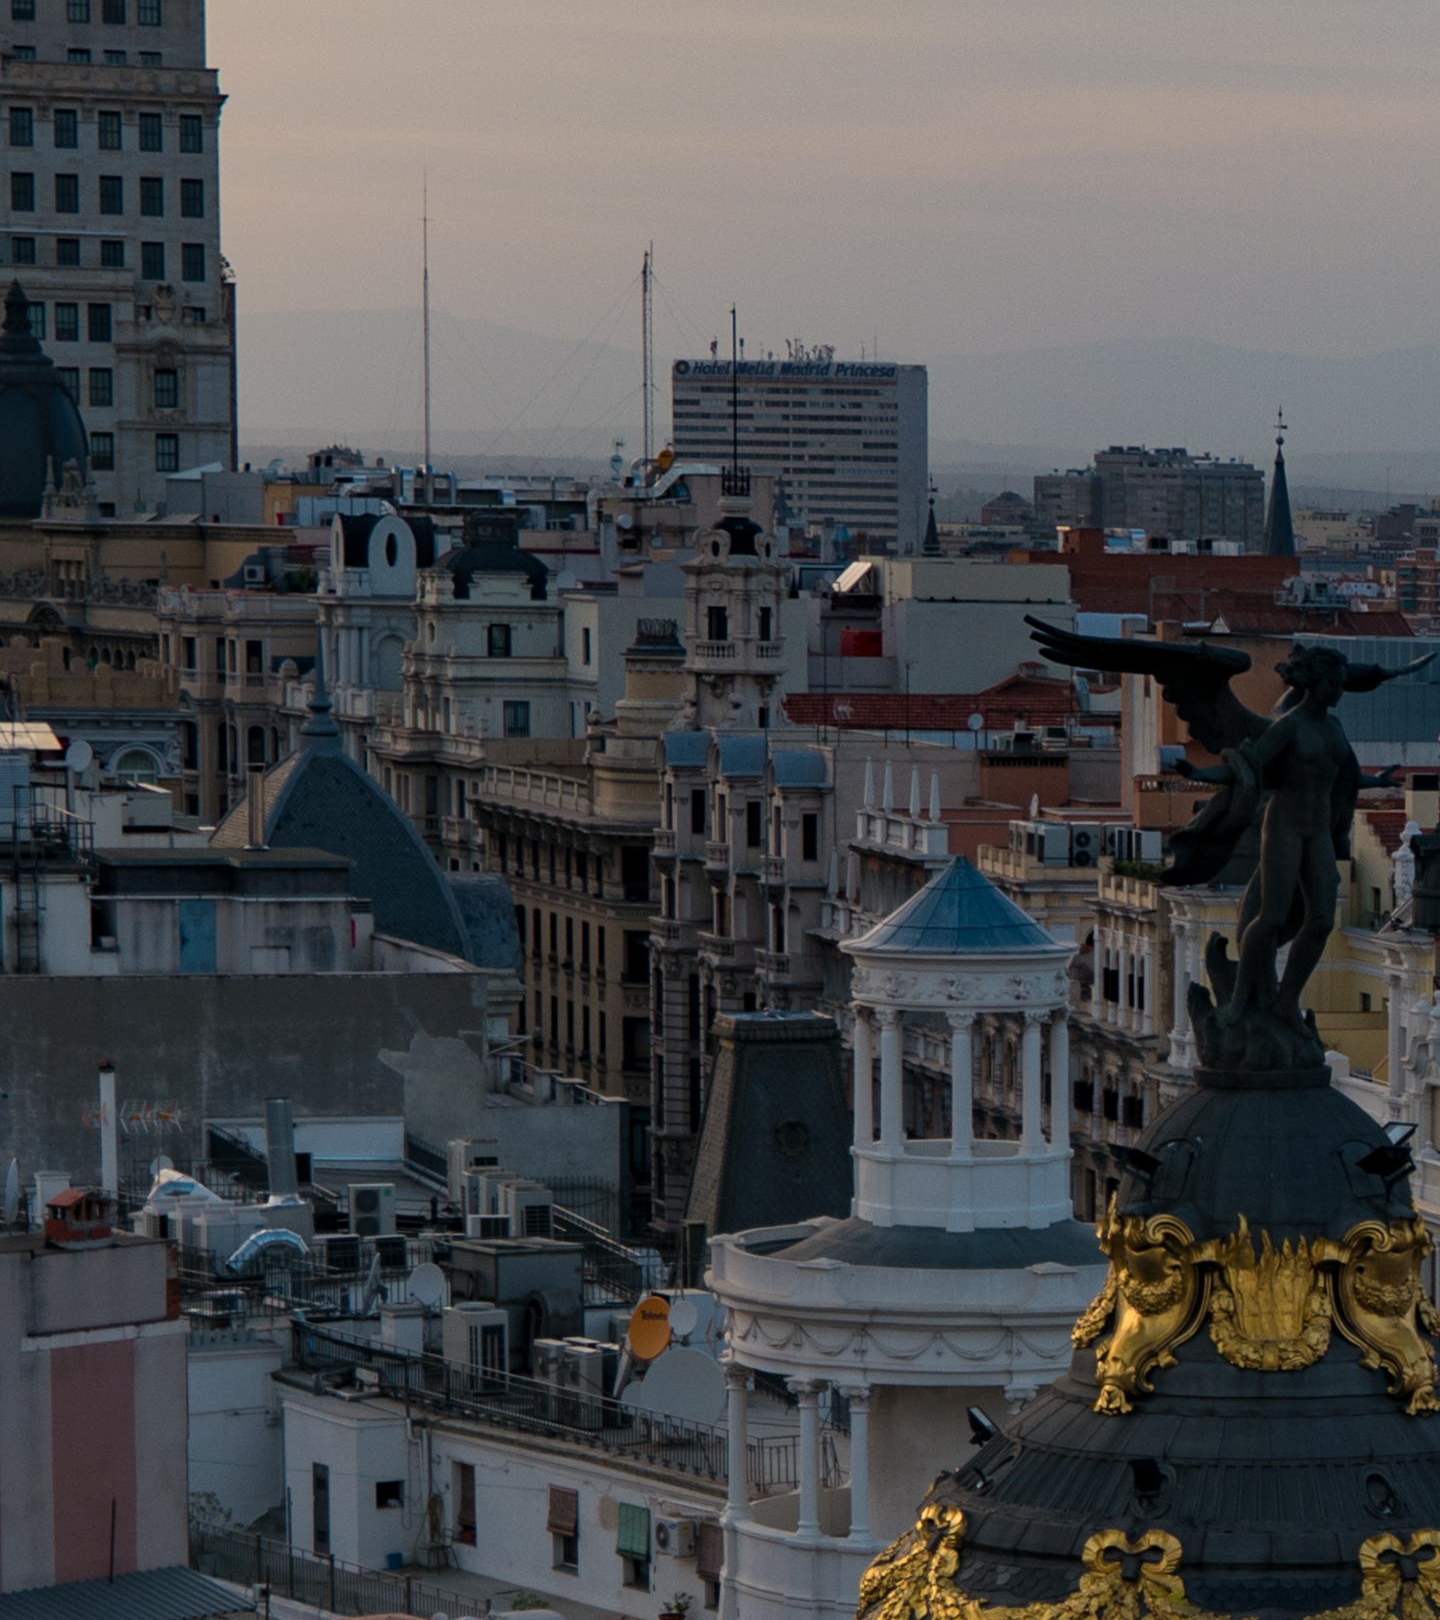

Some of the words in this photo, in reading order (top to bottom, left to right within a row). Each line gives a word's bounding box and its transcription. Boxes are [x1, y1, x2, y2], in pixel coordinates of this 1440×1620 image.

[692, 362, 731, 376] Hotel
[780, 363, 829, 377] Madrid
[835, 363, 896, 378] Princesa
